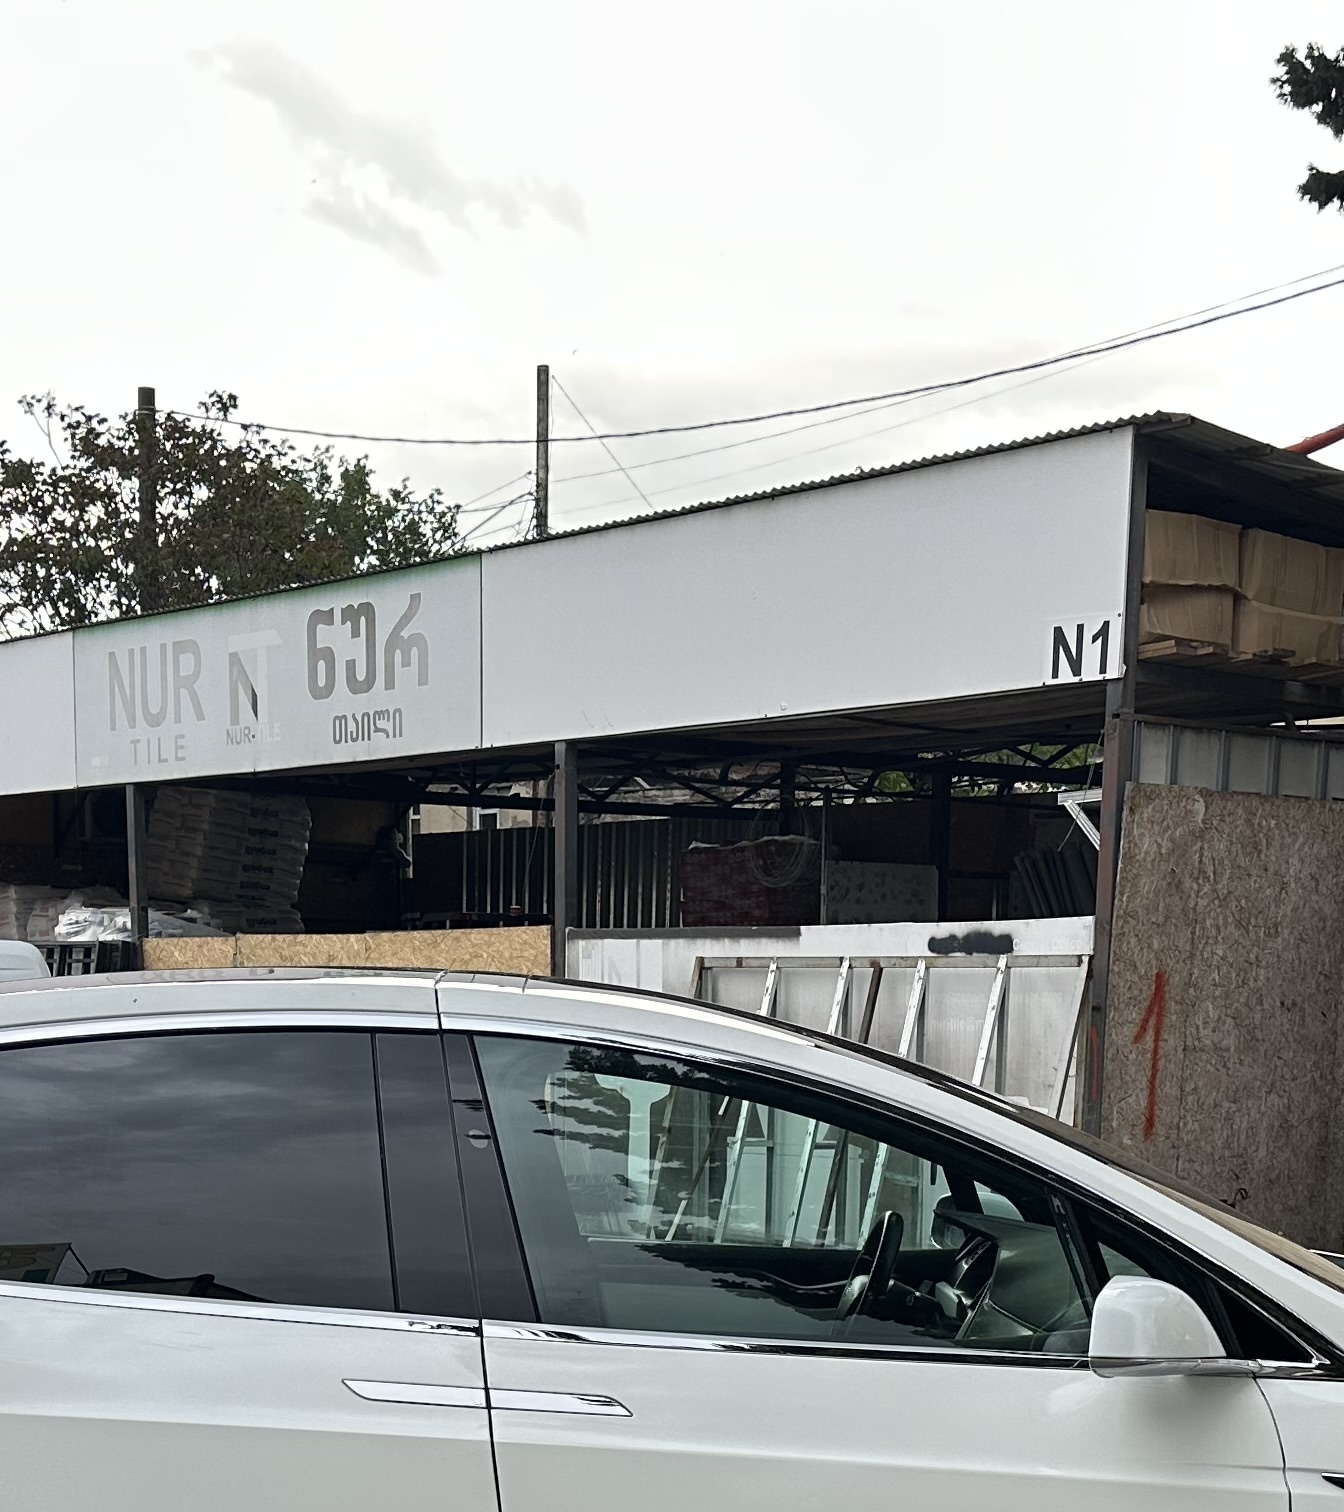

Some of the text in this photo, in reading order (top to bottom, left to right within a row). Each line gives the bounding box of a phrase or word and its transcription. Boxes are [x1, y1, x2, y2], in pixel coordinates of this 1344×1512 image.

[306, 592, 430, 701] ნურ
[1051, 620, 1110, 679] N1
[108, 639, 206, 732] NUR
[130, 733, 187, 767] TILE
[333, 707, 404, 745] თაილი
